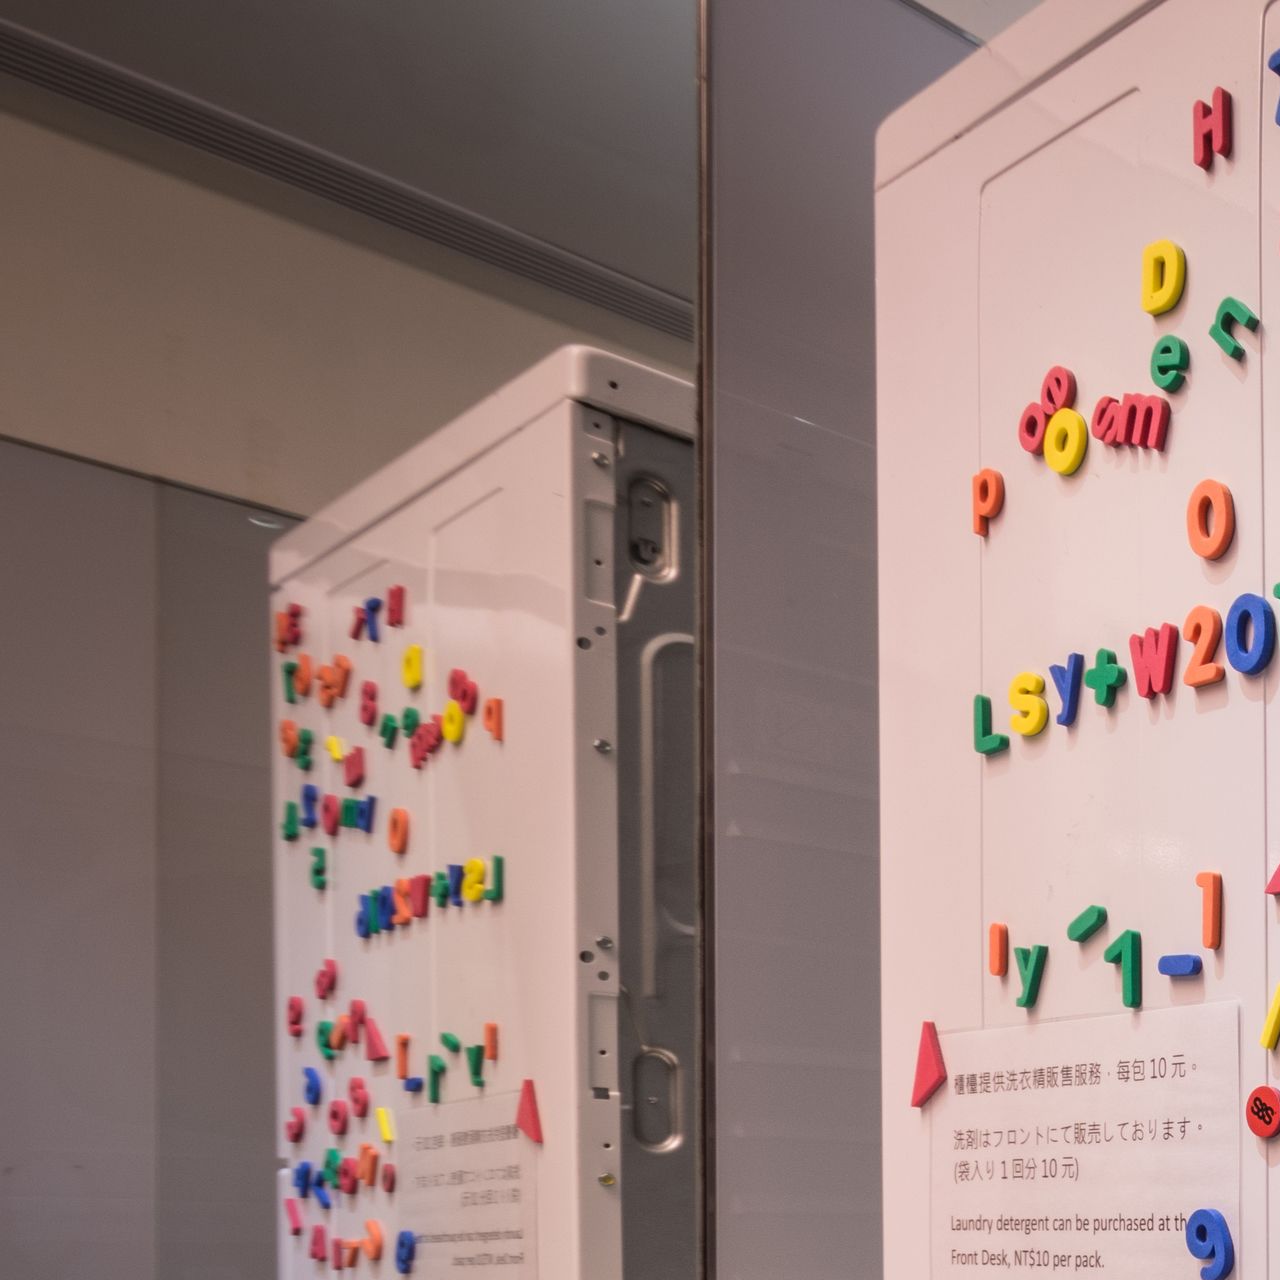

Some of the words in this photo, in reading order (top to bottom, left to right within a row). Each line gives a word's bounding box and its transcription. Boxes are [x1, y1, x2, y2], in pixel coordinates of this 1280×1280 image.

[1193, 86, 1232, 171] H
[1142, 239, 1187, 317] D
[1151, 334, 1190, 393] e
[1150, 1057, 1167, 1079] 10
[951, 1215, 993, 1234] Laundry
[996, 1214, 1049, 1235] detergent
[1052, 1218, 1072, 1231] can
[1075, 1214, 1090, 1231] be
[1093, 1213, 1154, 1235] purchased
[1158, 1215, 1171, 1231] at
[1174, 1214, 1188, 1231] th
[951, 1249, 978, 1266] Front
[981, 1249, 1011, 1268] Desk,
[1014, 1248, 1049, 1268] NT$10
[1053, 1253, 1072, 1268] per
[1075, 1251, 1104, 1271] pack.
